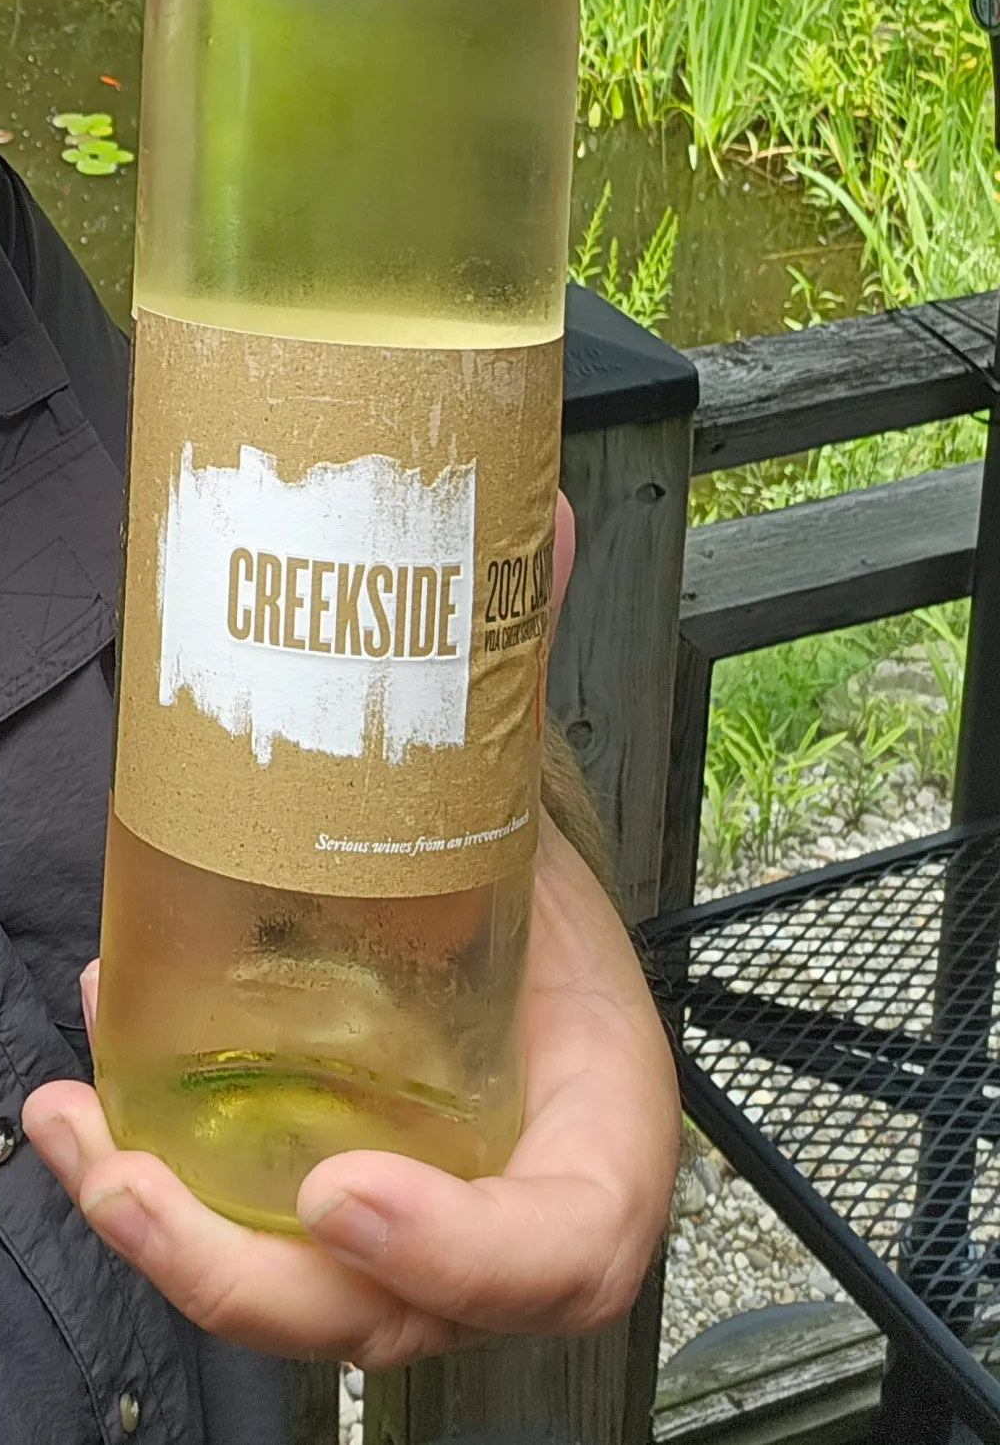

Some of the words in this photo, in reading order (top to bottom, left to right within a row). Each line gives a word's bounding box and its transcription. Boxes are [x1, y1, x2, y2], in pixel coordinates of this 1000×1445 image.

[227, 547, 463, 658] CREEKSIDE
[485, 555, 529, 623] 2021
[315, 832, 369, 854] Serious
[372, 837, 411, 854] wines
[411, 835, 445, 857] from
[447, 838, 463, 850] an
[464, 822, 511, 847] irreverent
